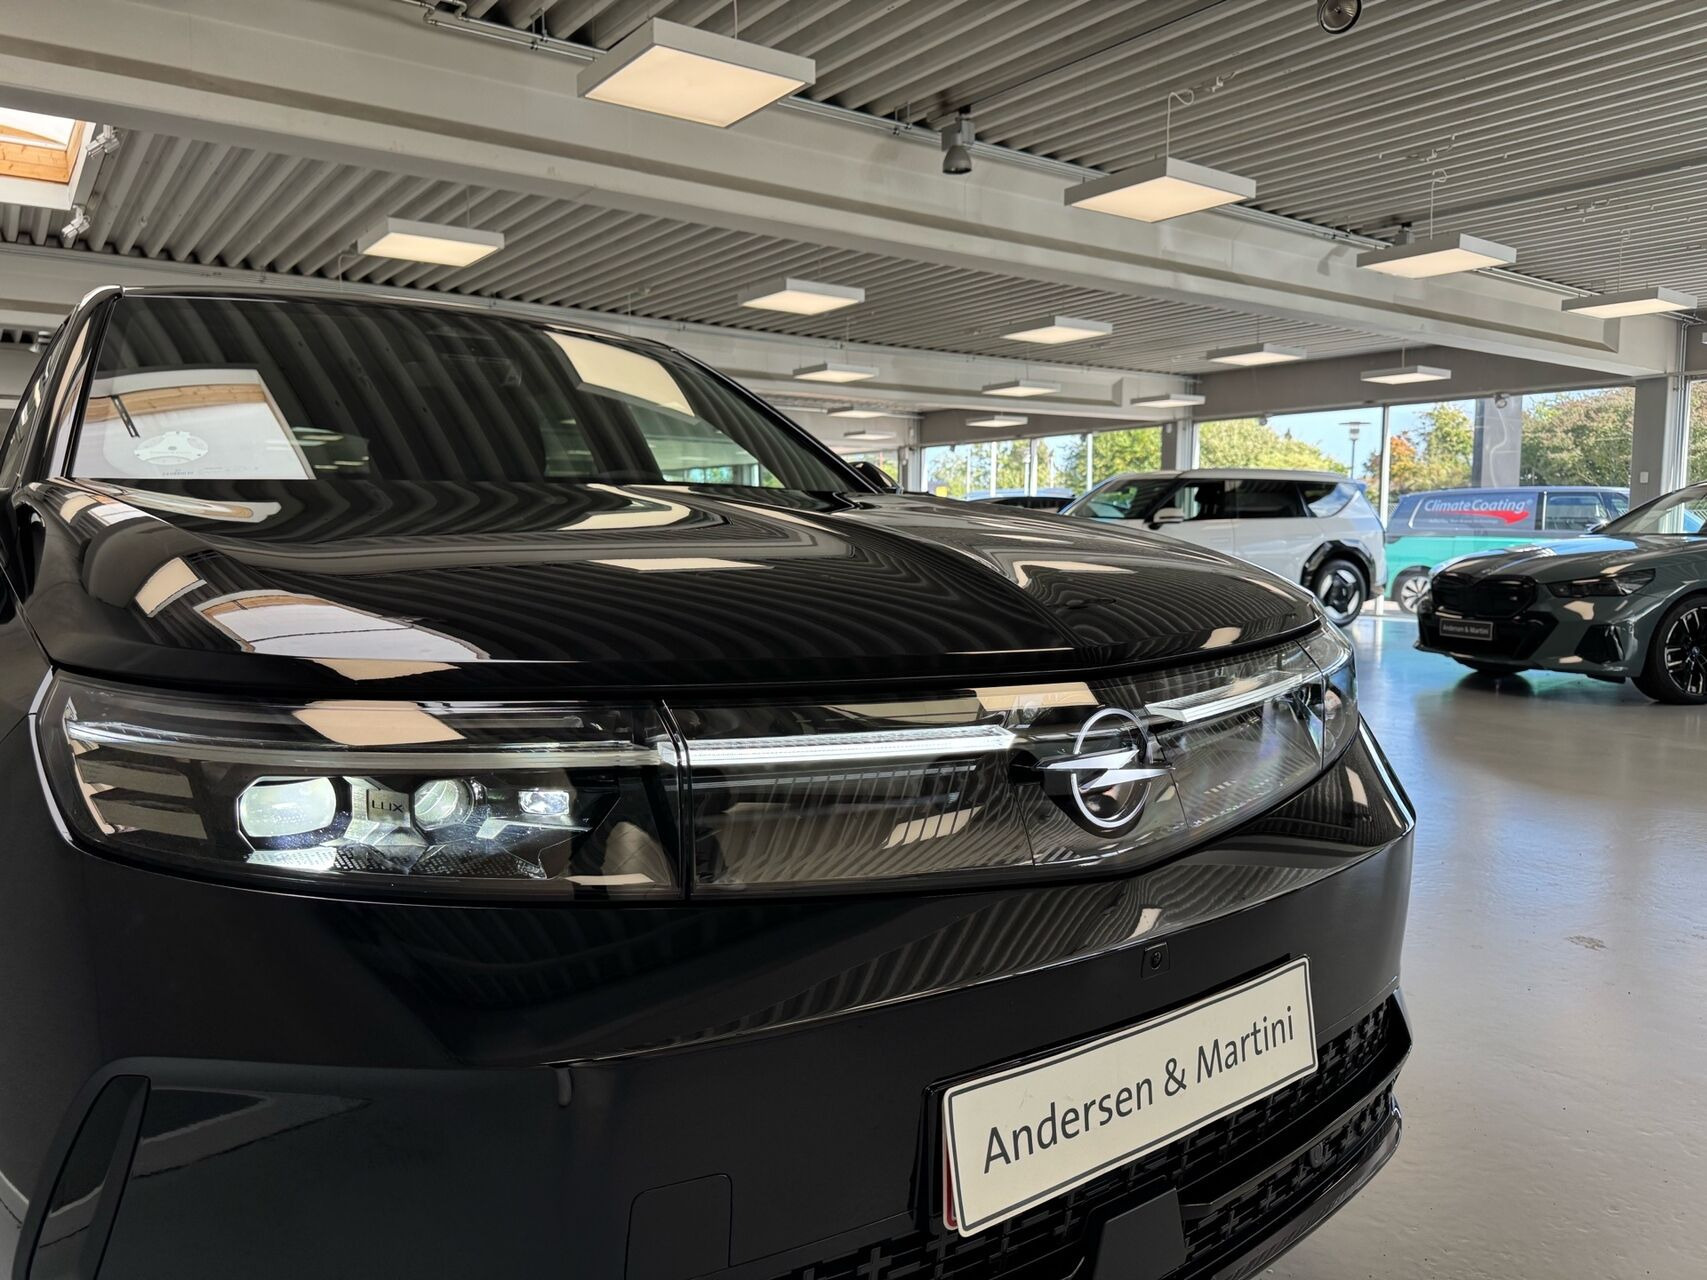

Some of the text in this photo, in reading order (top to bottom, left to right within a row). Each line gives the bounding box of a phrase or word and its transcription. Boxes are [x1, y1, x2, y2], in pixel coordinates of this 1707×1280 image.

[983, 1006, 1294, 1174] Andersen & Martini
